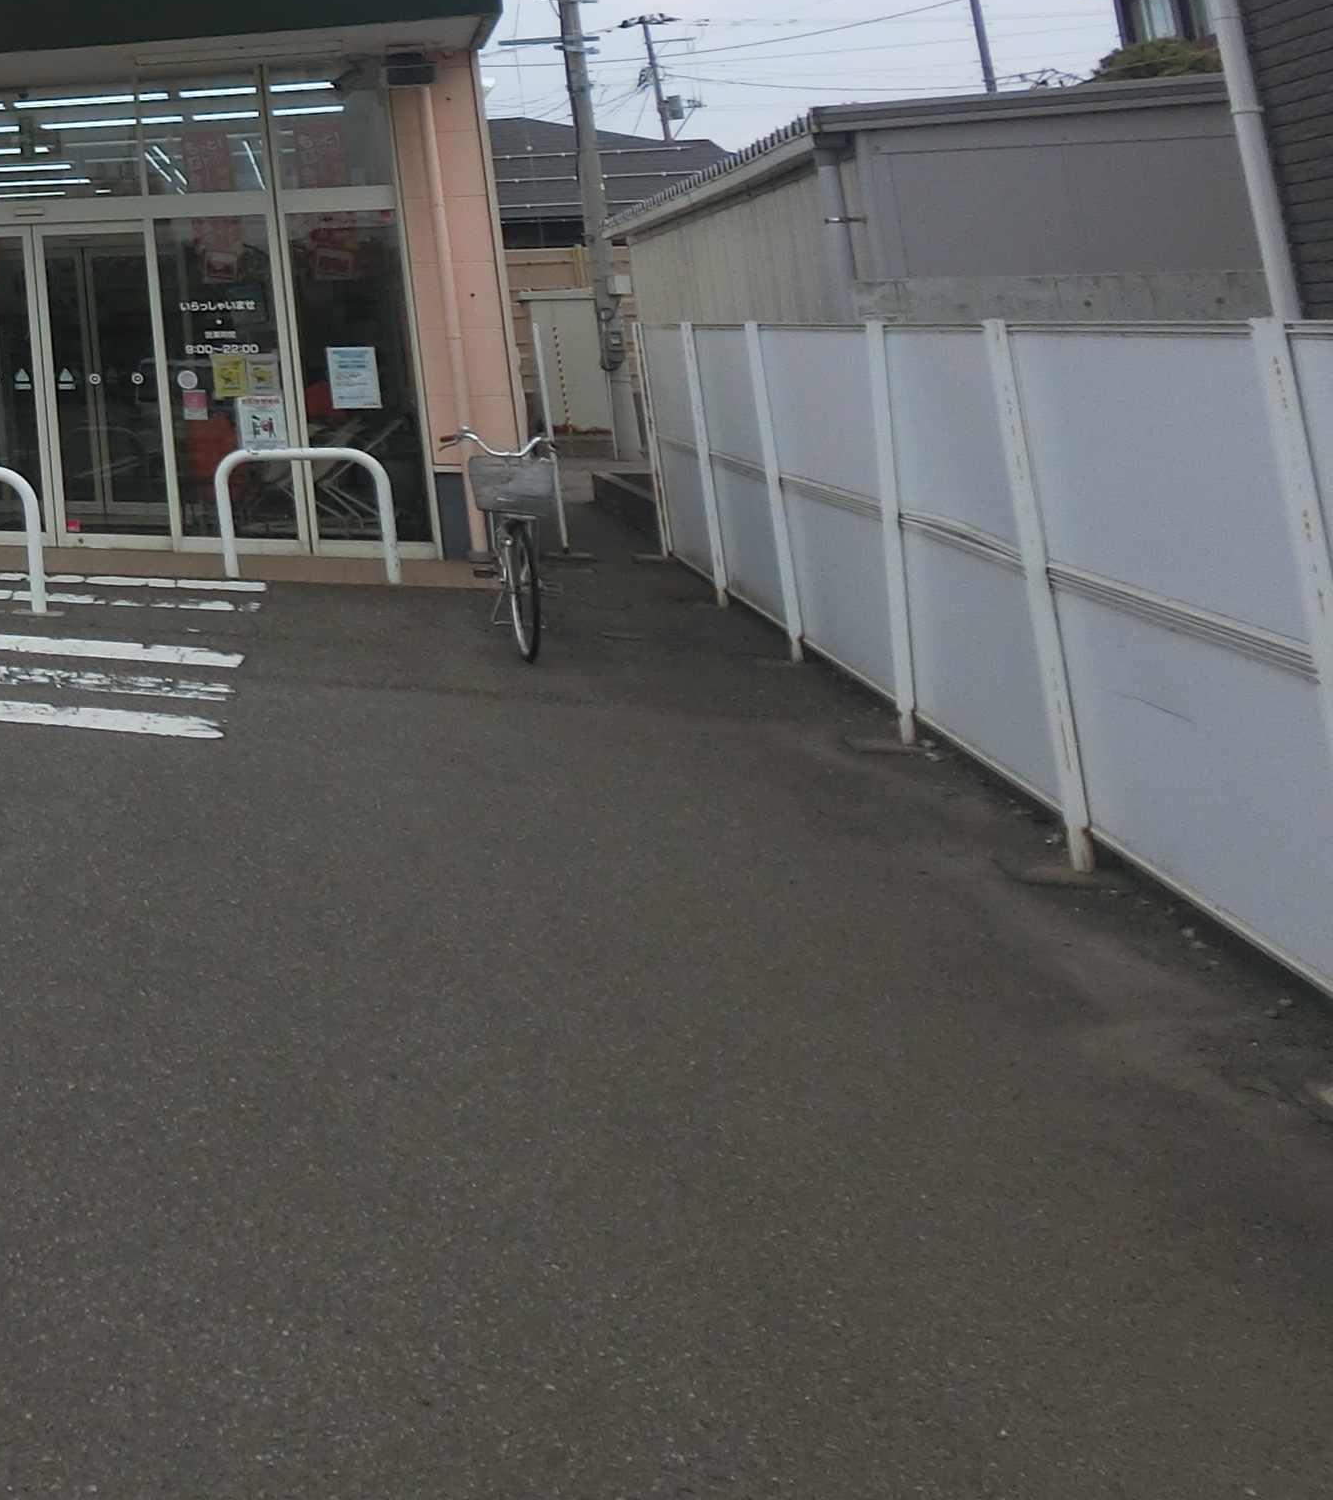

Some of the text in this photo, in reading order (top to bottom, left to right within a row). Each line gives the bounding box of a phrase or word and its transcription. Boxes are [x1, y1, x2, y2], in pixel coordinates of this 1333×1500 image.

[180, 300, 256, 312] いらっしゃいませ
